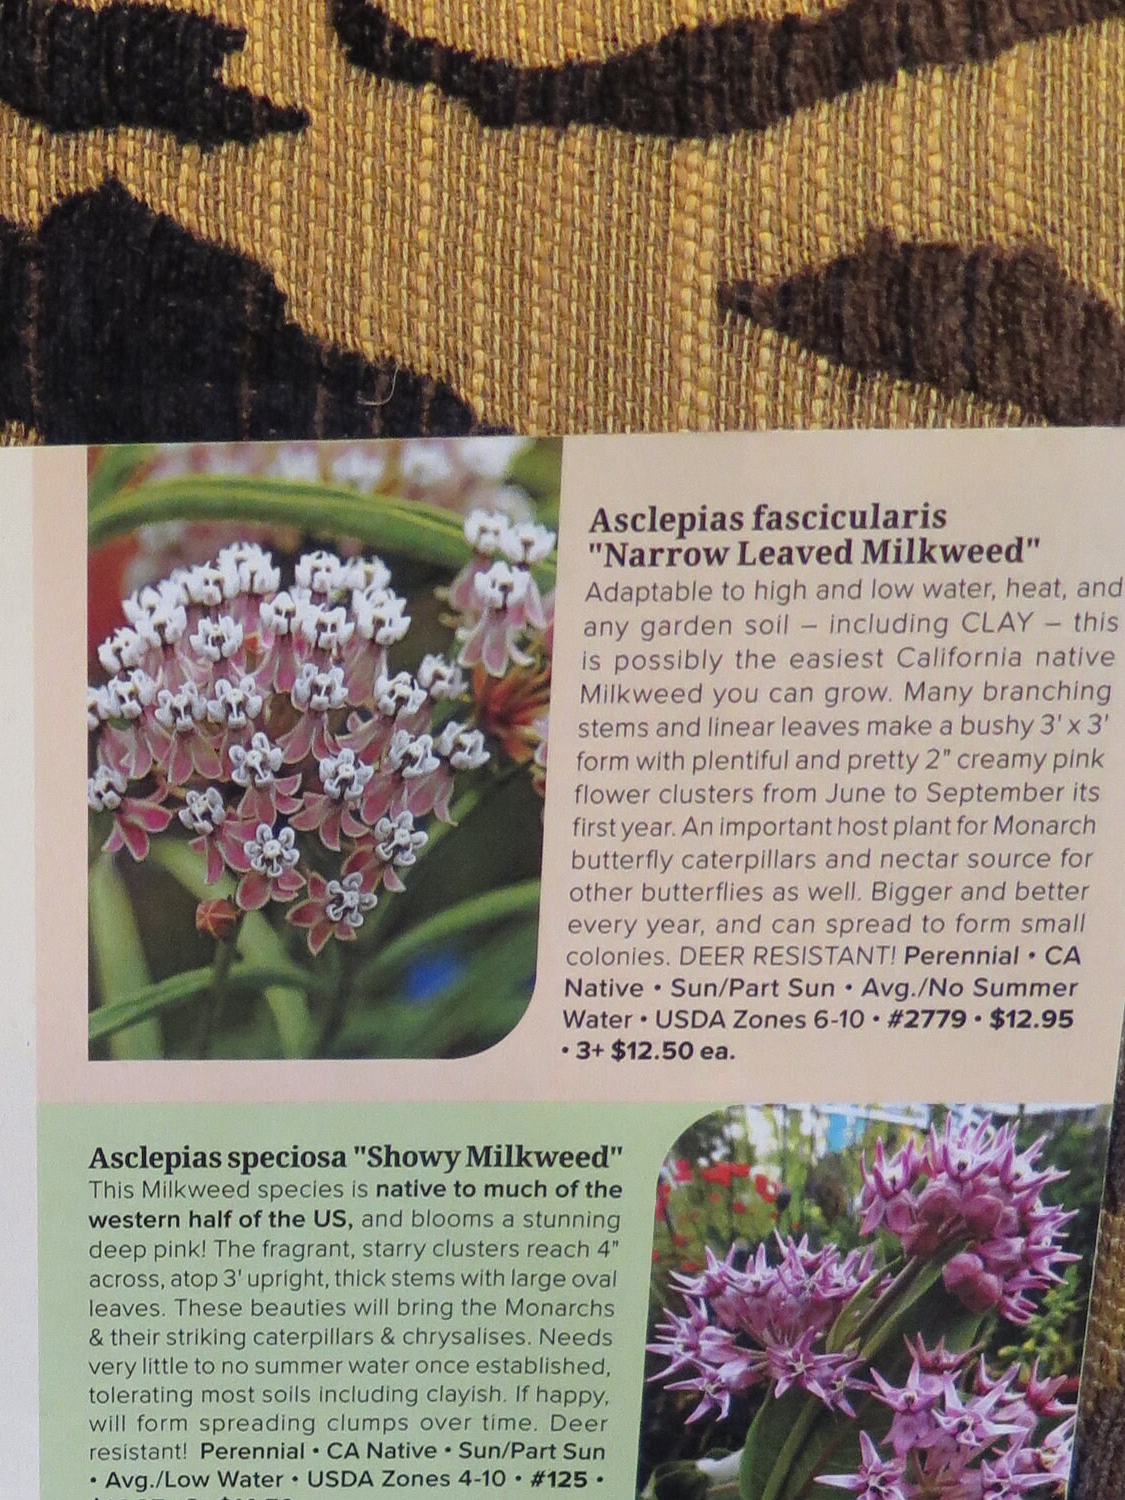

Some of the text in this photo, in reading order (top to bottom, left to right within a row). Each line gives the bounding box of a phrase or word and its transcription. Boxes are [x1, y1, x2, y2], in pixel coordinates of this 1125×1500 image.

[588, 501, 947, 539] Asclepias fascicularis
[589, 536, 1040, 568] "Narrow Leaved Milkweed"
[582, 646, 1115, 675] is possibly the easiest California native
[574, 781, 1100, 807] flower clusters from June to September its
[563, 1006, 1073, 1031] Water USDA Zones 6-10 #2779 $12.95
[575, 1038, 735, 1062] 3+ $12.50 ea.
[88, 1144, 623, 1173] Asclepias speciosa "Showy Milkweed"
[88, 1208, 620, 1234] western half of the US, and blooms a stunning
[89, 1297, 615, 1320] leaves. These beauties will bring the Monarchs
